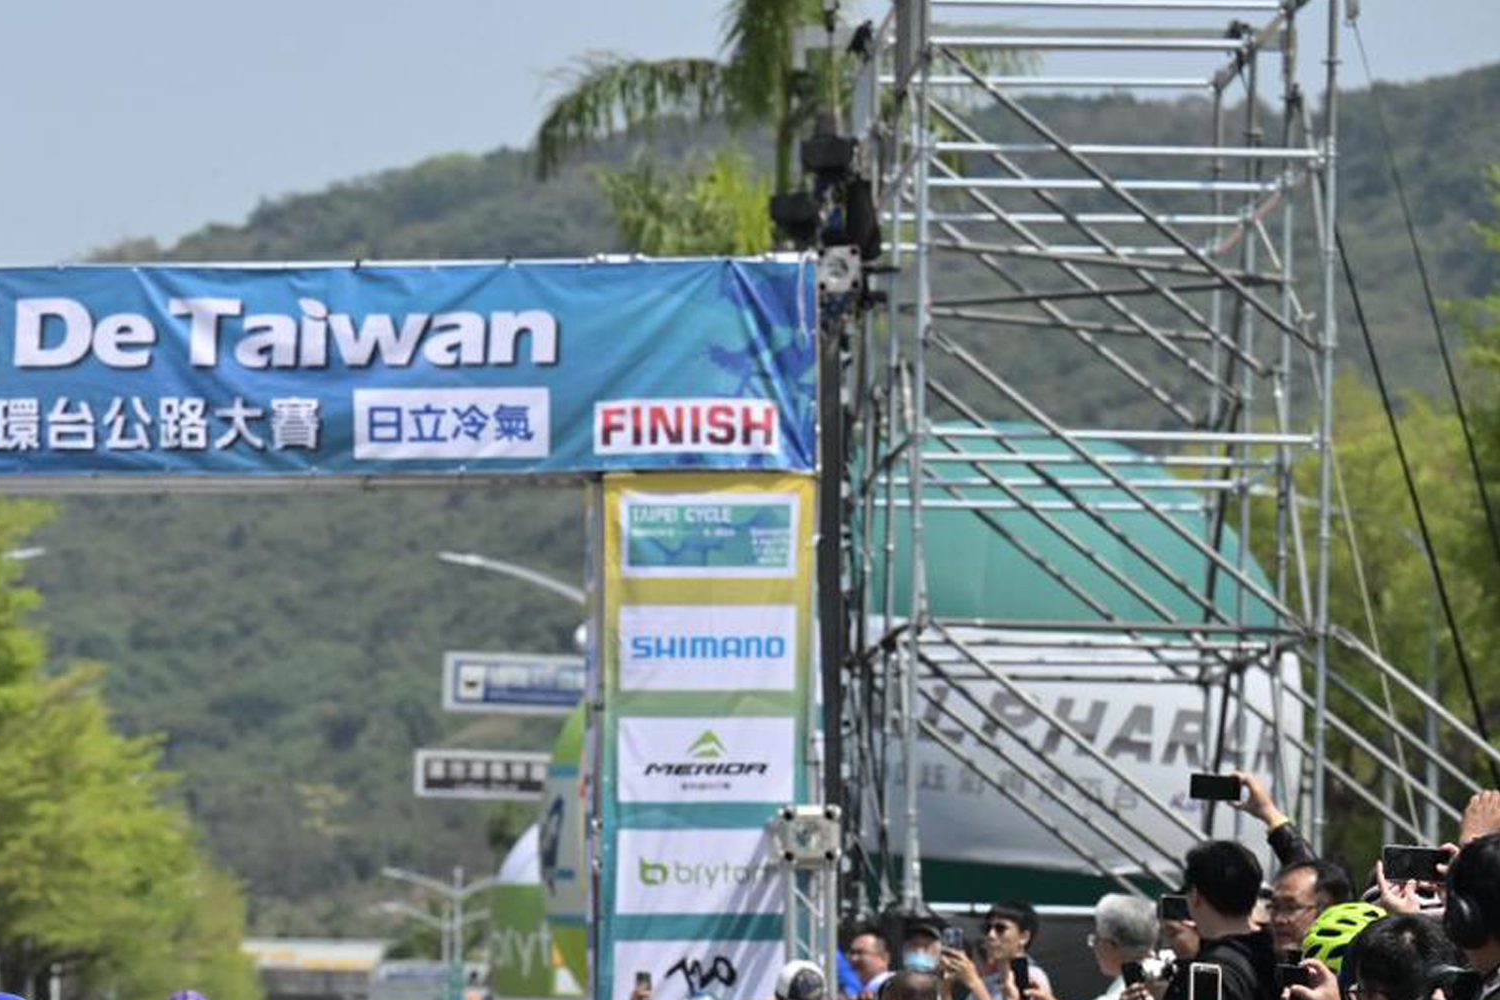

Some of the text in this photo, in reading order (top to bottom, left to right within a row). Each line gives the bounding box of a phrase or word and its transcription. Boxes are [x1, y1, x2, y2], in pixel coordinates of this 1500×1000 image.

[13, 298, 156, 369] De
[167, 297, 558, 370] Taiwan
[366, 403, 535, 444] 日立冷氣
[600, 400, 776, 447] FINISH
[631, 506, 733, 523] TAIPEI CYCLE
[631, 635, 786, 660] SHIMANO
[643, 762, 770, 777] MERIDA
